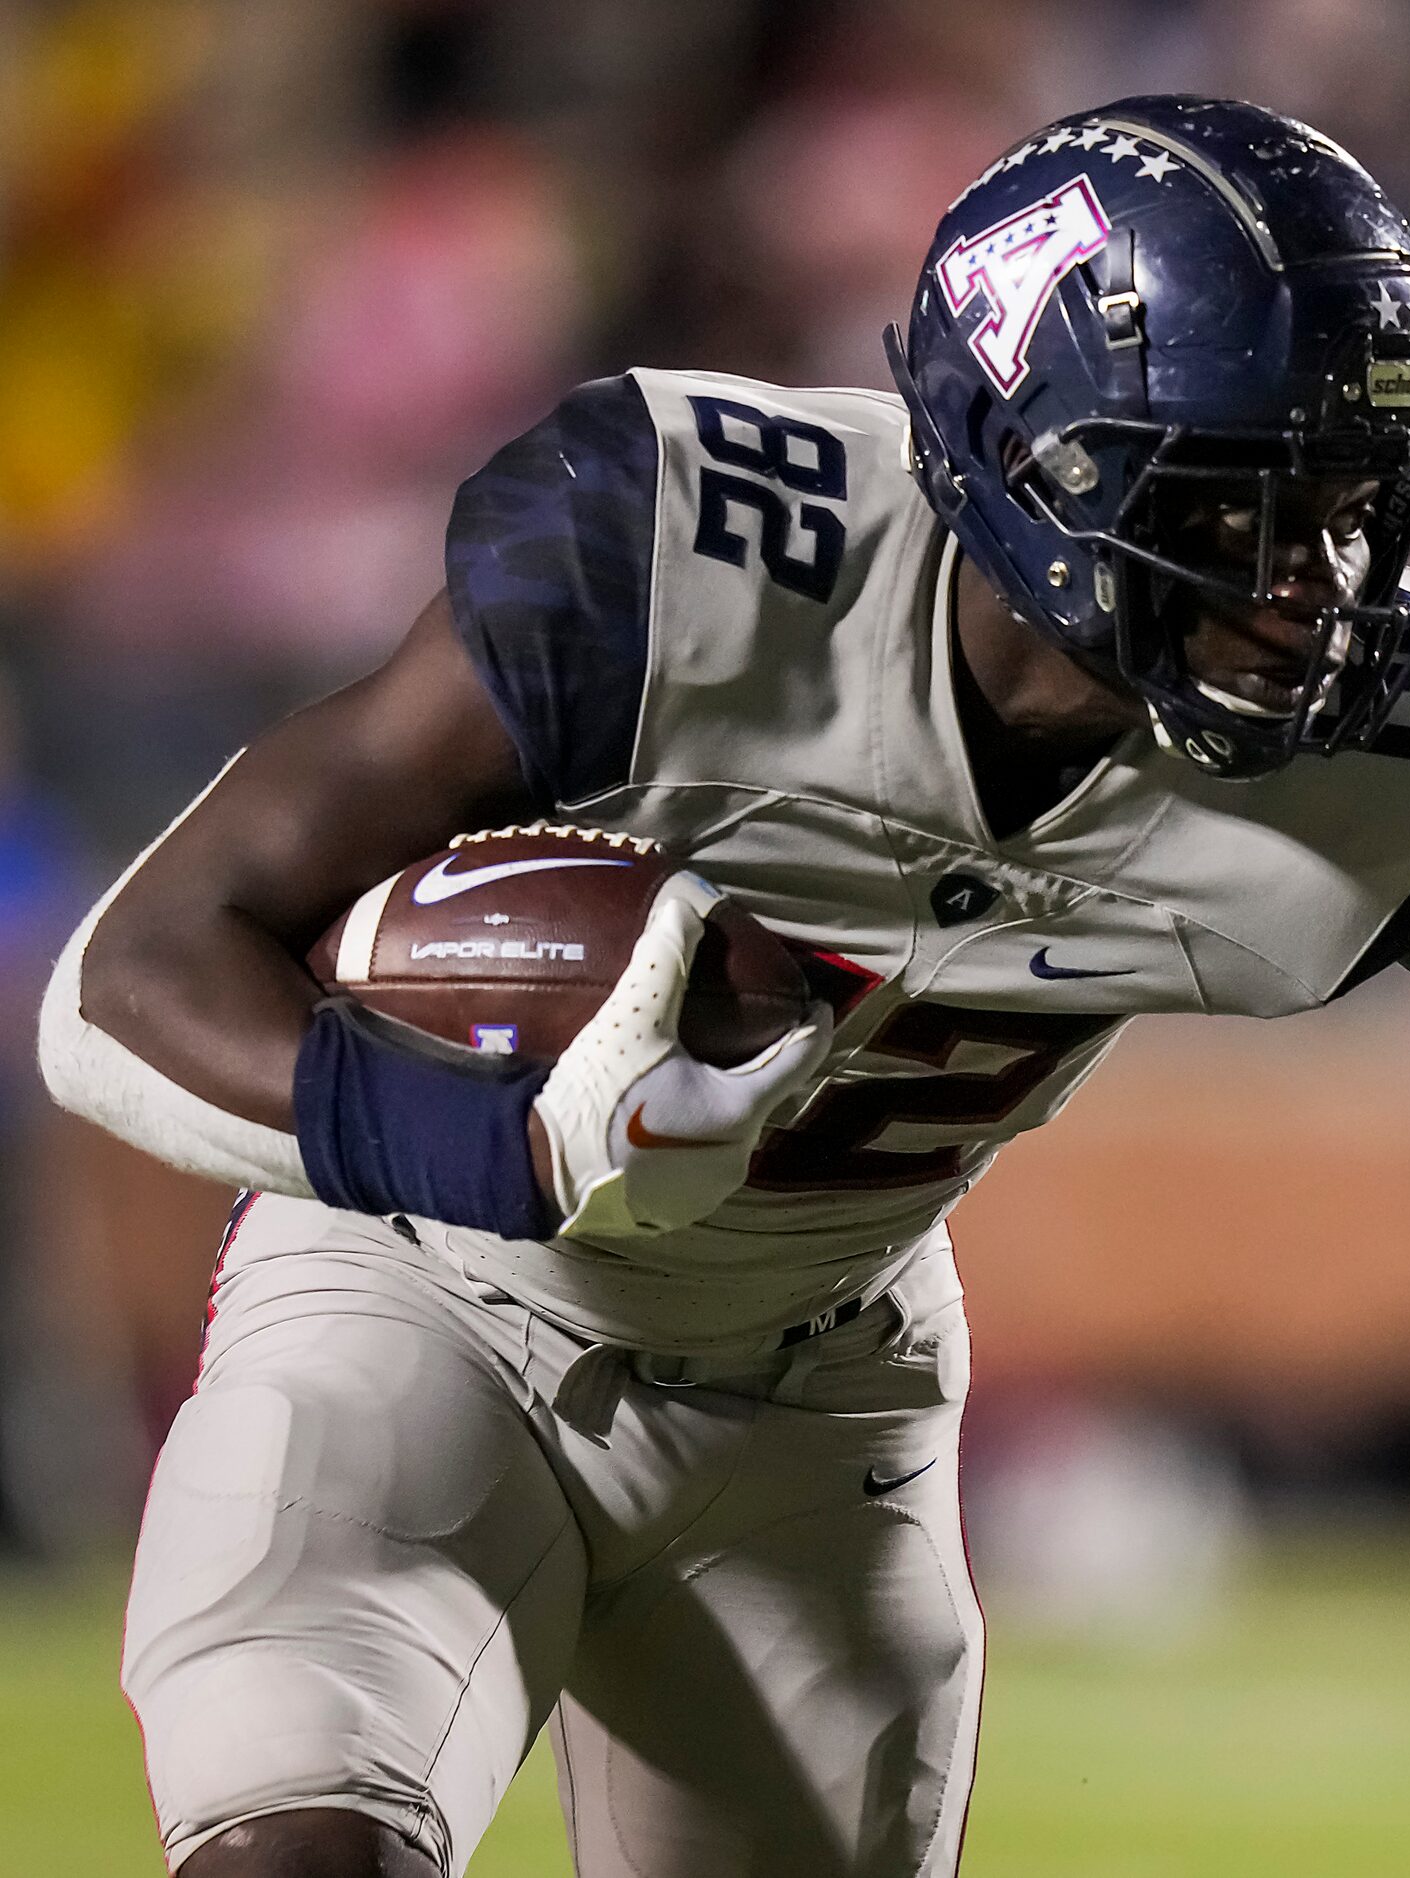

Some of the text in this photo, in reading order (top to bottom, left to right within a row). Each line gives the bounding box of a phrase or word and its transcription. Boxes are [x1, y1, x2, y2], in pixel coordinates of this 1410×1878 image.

[936, 173, 1112, 400] A
[685, 395, 847, 605] 28
[944, 888, 974, 911] A
[410, 940, 585, 961] VAPOR ELITE
[808, 1308, 837, 1336] M
